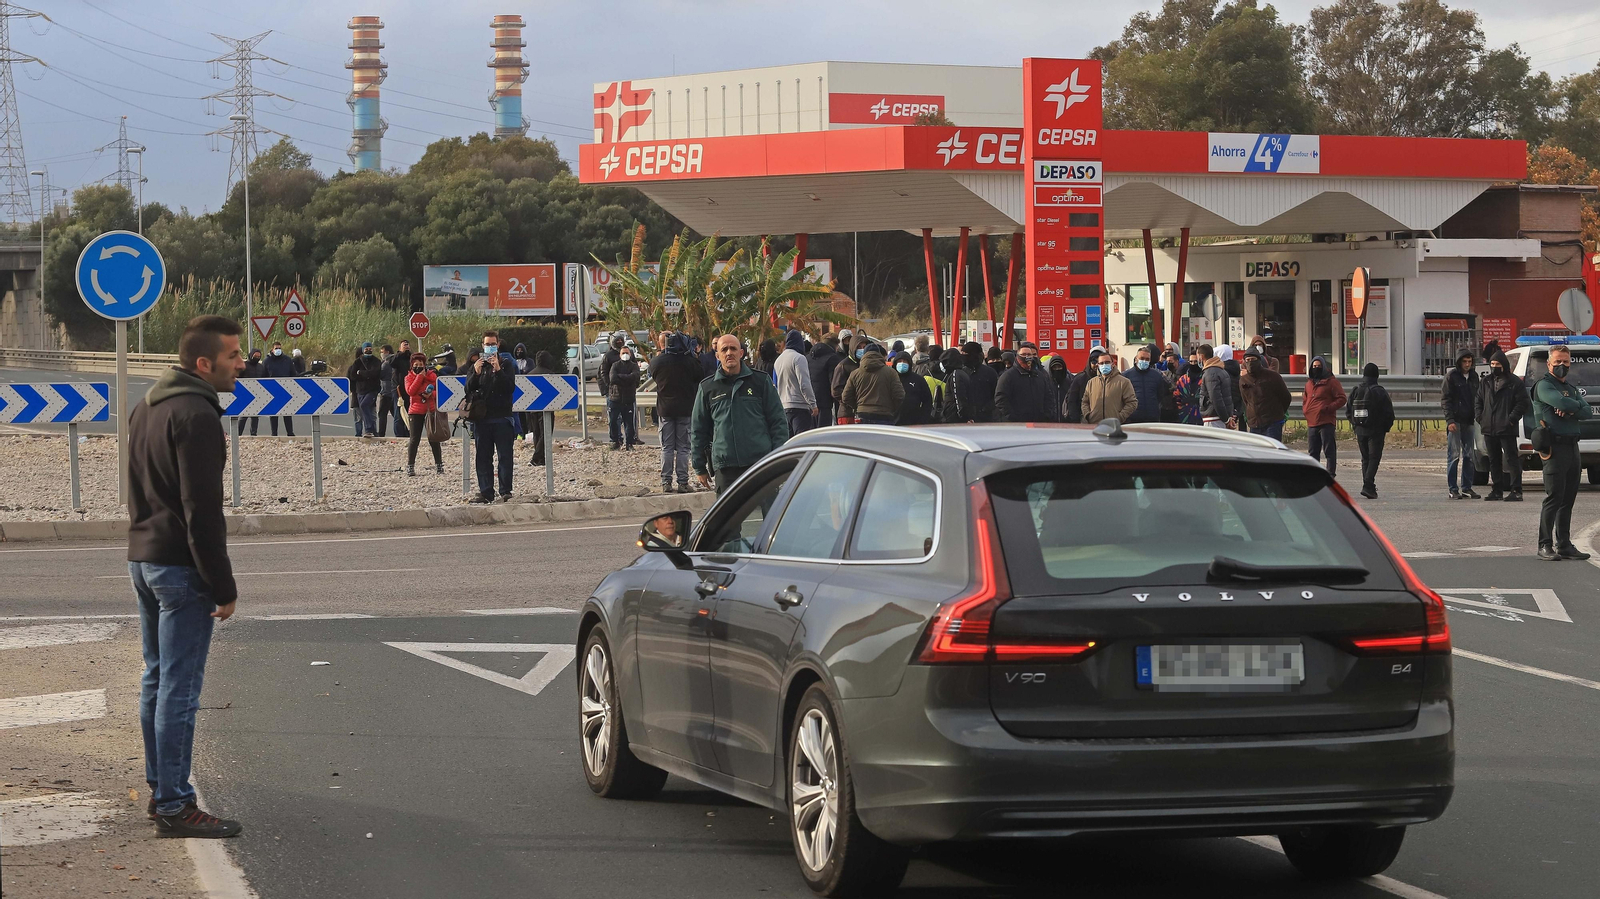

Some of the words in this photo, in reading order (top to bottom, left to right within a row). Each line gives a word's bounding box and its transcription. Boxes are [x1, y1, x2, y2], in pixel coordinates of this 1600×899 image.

[892, 103, 939, 117] CEPSA
[1037, 128, 1097, 146] CEPSA
[625, 143, 704, 176] CEPSA
[1211, 145, 1246, 157] Ahorra
[1254, 136, 1282, 171] 4%
[1040, 165, 1096, 180] DEPASO
[1051, 193, 1084, 205] optima
[1047, 240, 1056, 248] 95
[1245, 260, 1300, 278] DEPASO
[508, 277, 536, 294] 2x1
[1056, 288, 1064, 296] 95
[289, 323, 302, 331] 80
[1132, 589, 1314, 602] VOLVO
[1141, 667, 1149, 677] E
[1390, 663, 1412, 675] B4
